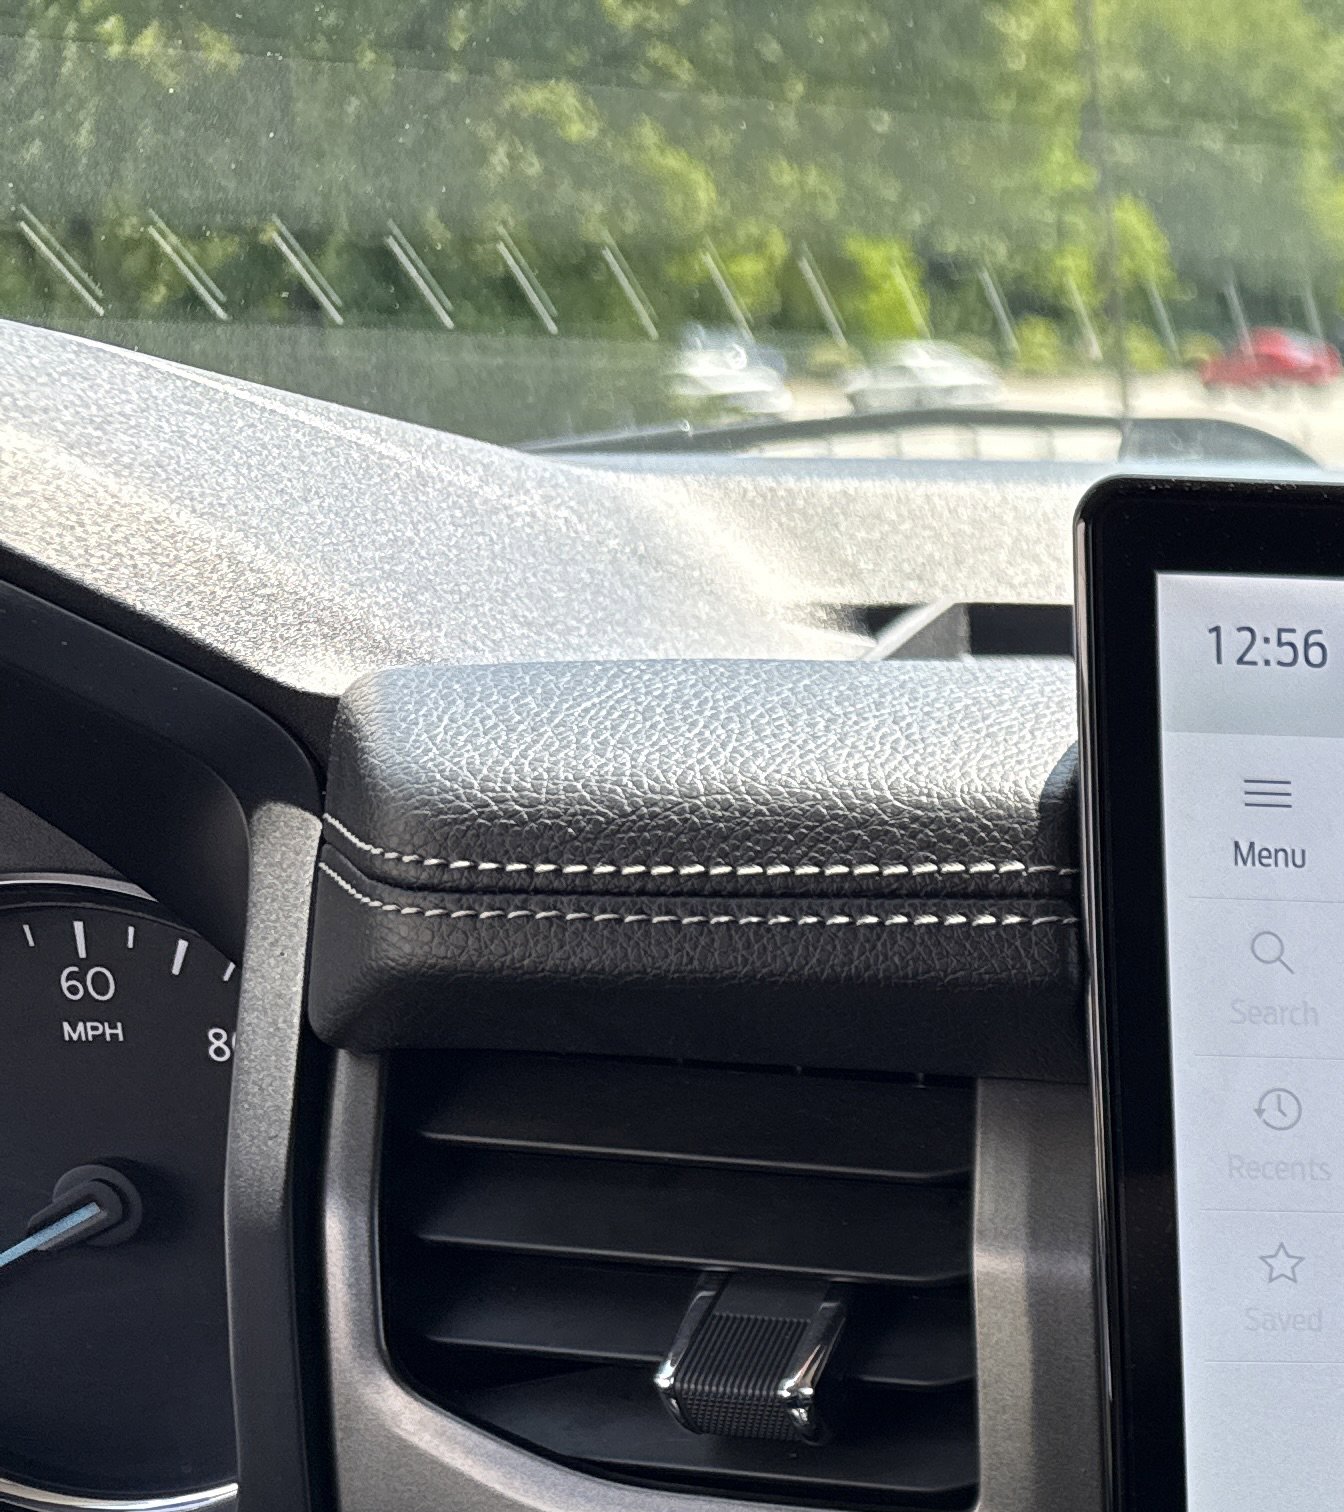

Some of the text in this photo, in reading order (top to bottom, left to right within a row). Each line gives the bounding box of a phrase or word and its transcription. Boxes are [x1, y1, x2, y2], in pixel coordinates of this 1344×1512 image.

[1207, 624, 1329, 669] 12:56
[1233, 840, 1307, 869] Menu
[60, 965, 116, 1002] 60
[1229, 998, 1320, 1027] Search
[62, 1021, 124, 1043] MPH
[207, 1028, 236, 1062] 8
[1227, 1154, 1333, 1182] Recents
[1243, 1307, 1323, 1333] Saved
